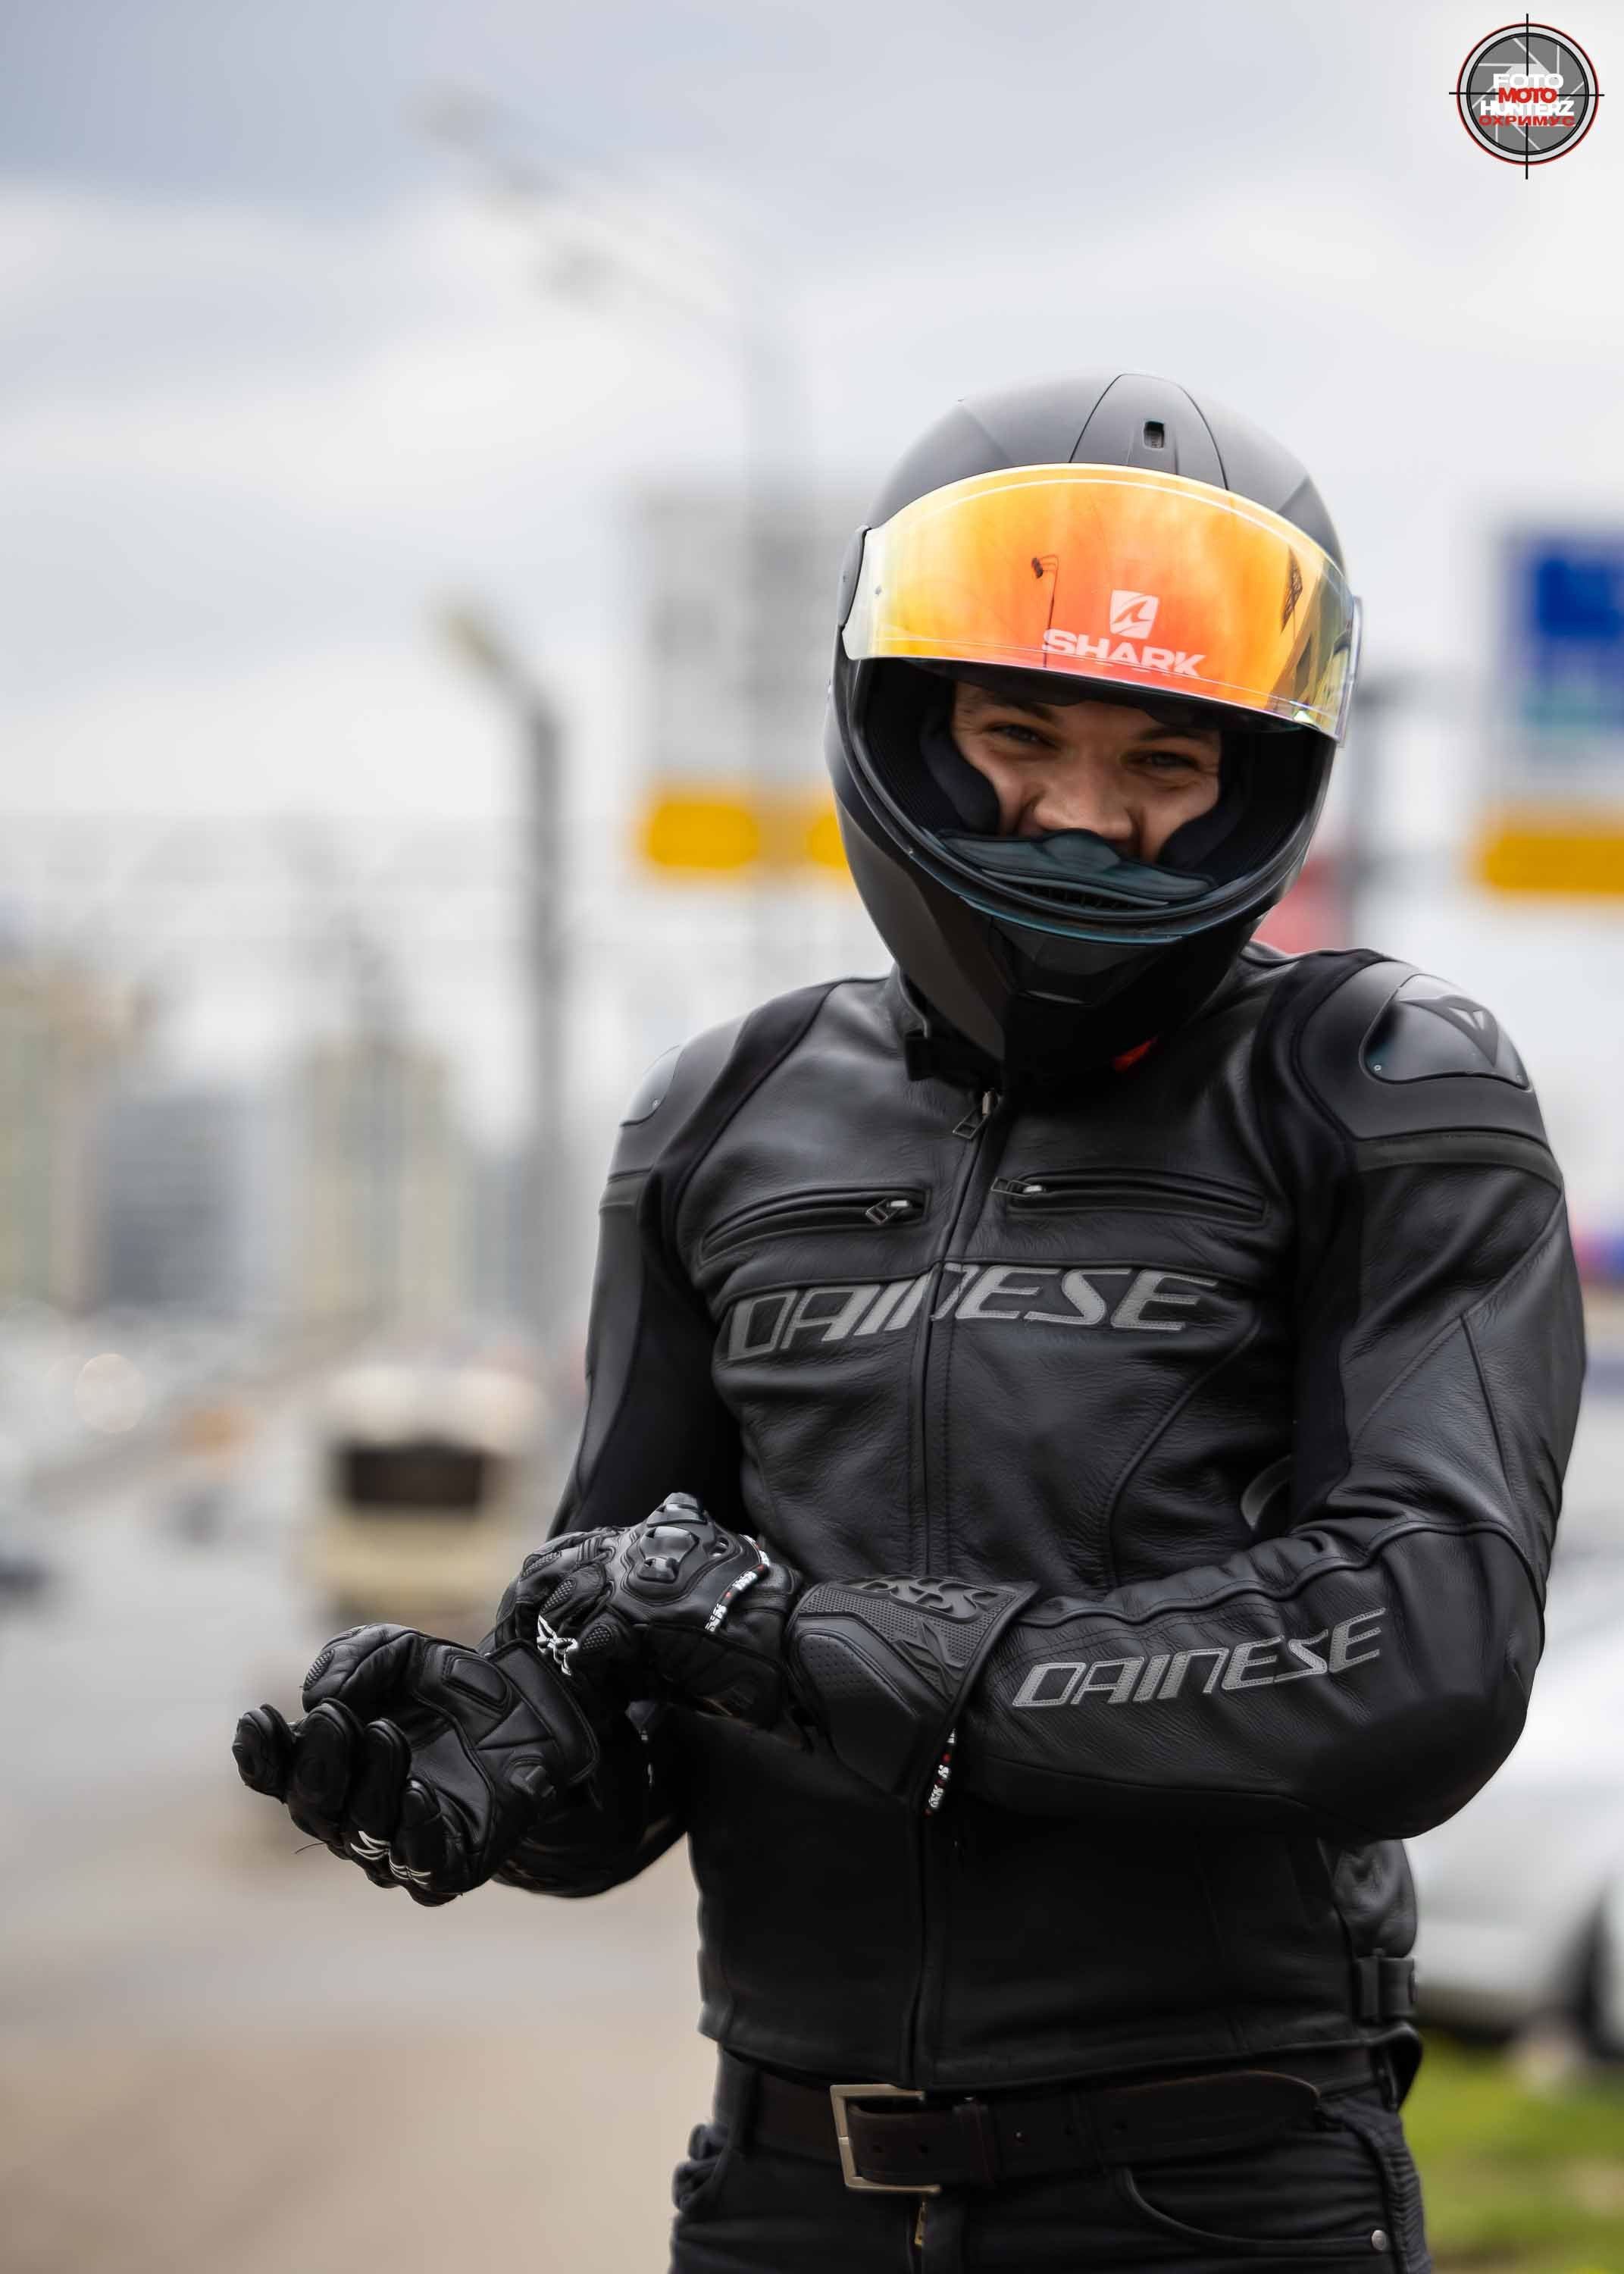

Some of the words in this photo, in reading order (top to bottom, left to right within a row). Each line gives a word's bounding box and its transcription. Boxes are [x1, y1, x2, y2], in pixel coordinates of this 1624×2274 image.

[1041, 628, 1206, 677] SHARK
[728, 1262, 1216, 1361] DAINESE
[1012, 1607, 1387, 1707] DAINESE
